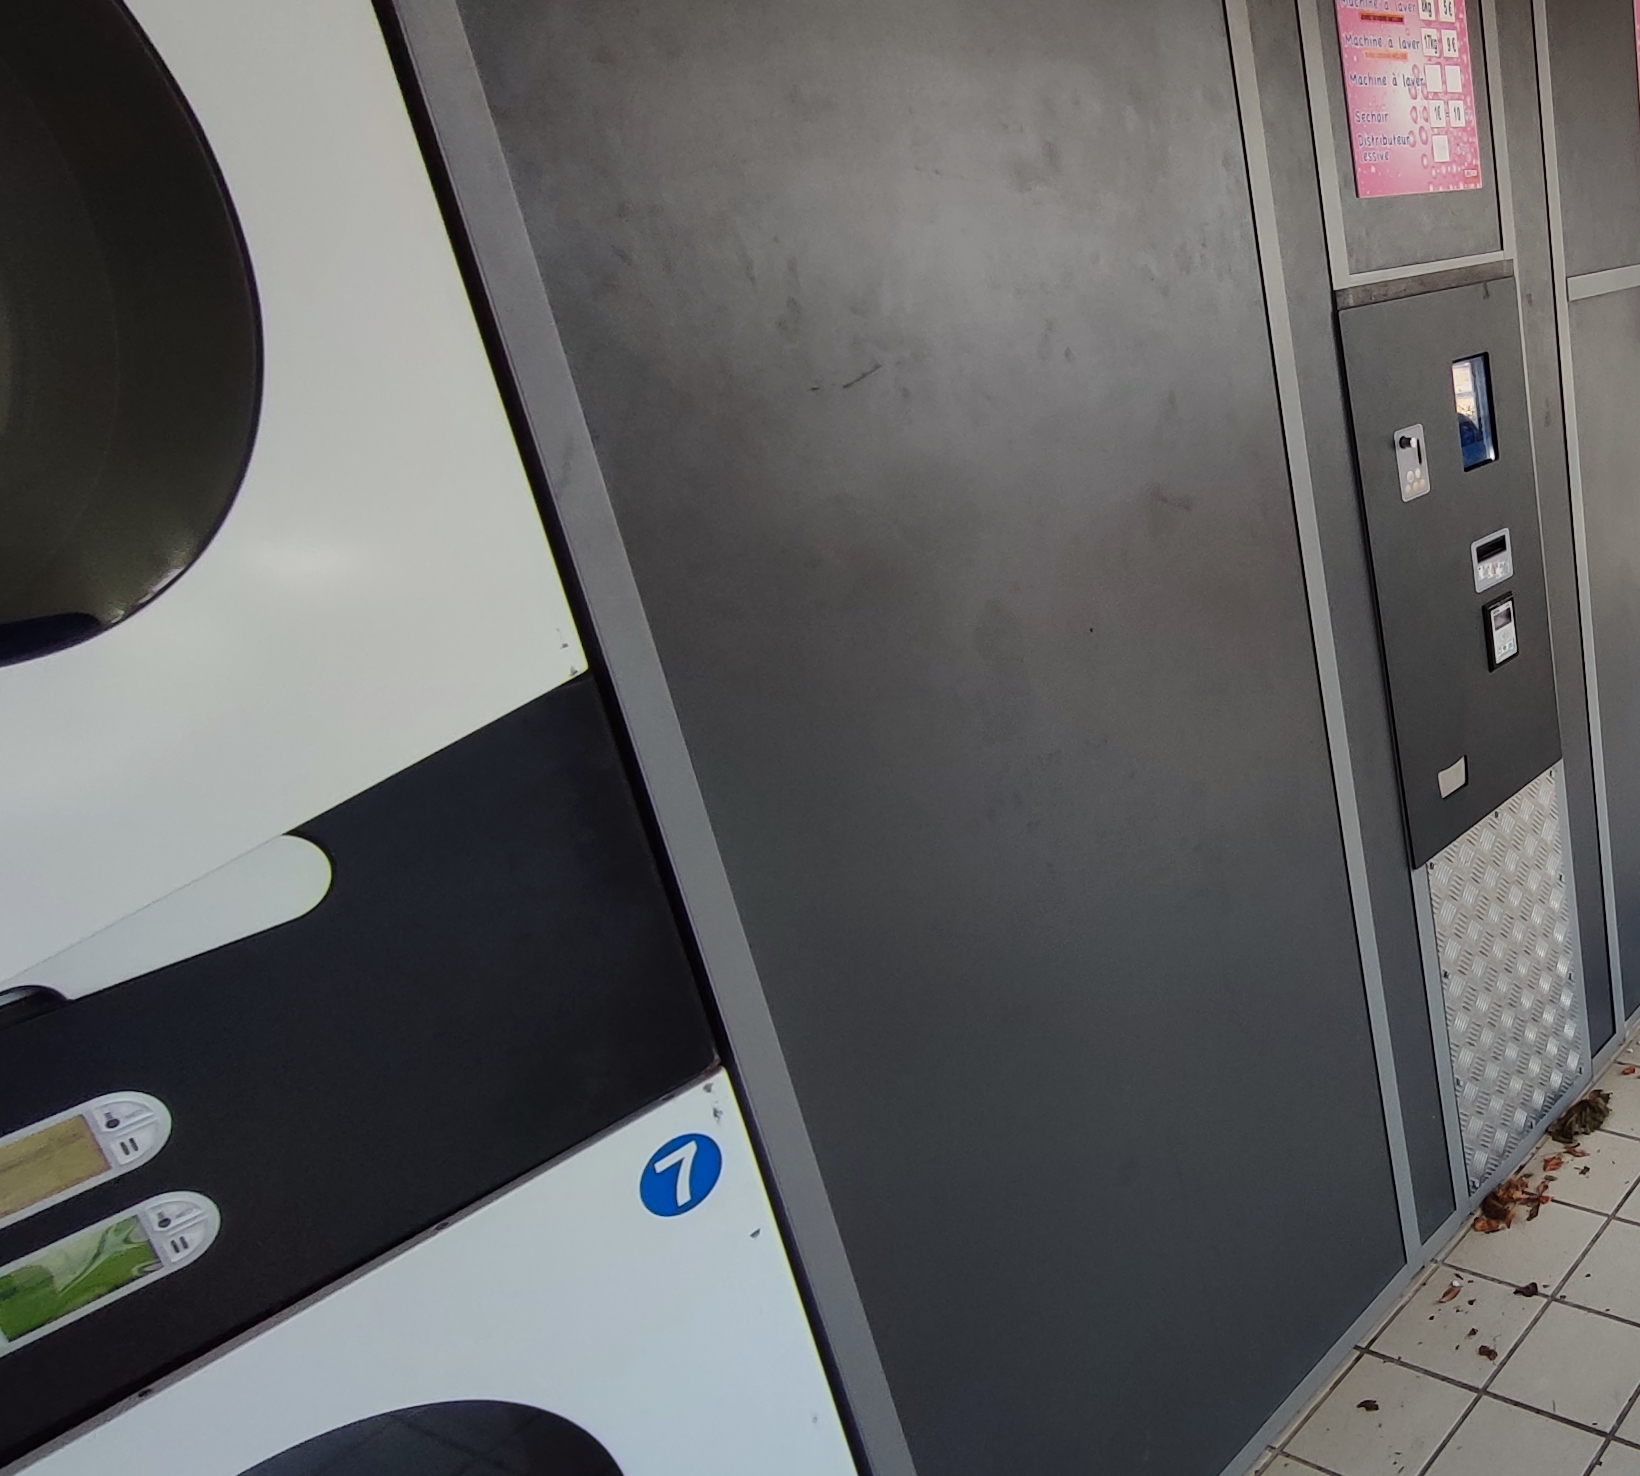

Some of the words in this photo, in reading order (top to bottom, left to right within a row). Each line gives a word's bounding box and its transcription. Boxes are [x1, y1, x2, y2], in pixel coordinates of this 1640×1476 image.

[1396, 1, 1416, 13] laver
[1345, 34, 1382, 47] Machine
[1399, 36, 1420, 50] laver
[1350, 72, 1387, 86] Machine
[1402, 73, 1424, 87] laver
[1357, 134, 1410, 146] Distributeur
[653, 1139, 698, 1207] 7
